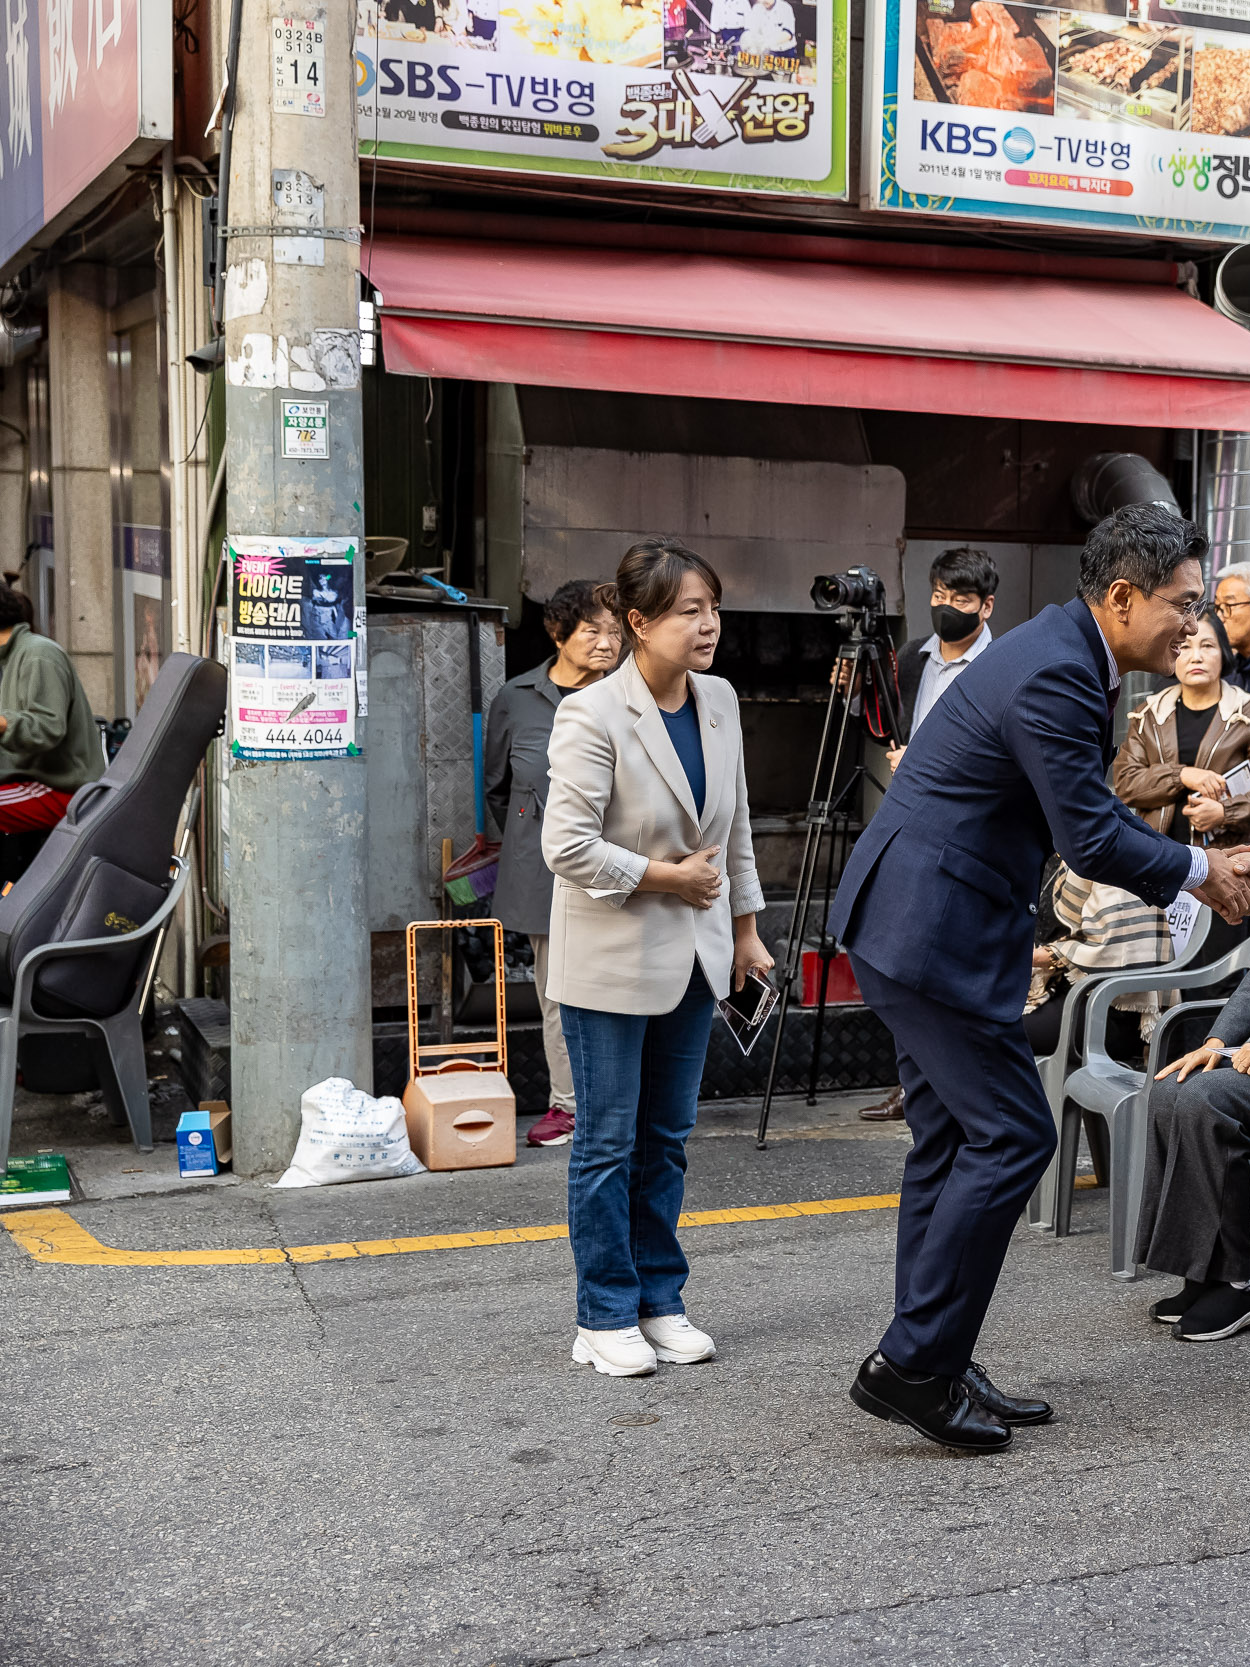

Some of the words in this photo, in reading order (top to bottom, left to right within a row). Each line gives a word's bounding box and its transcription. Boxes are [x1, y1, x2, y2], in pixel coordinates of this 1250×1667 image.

[275, 28, 323, 43] 0324B
[285, 42, 313, 54] 513
[289, 59, 319, 86] 14
[394, 110, 416, 122] 20일
[418, 112, 439, 125] 방영
[458, 114, 499, 131] 백종원의
[501, 119, 541, 135] 맛집탐험
[921, 119, 997, 158] KBS
[918, 163, 949, 177] 2011년
[969, 168, 983, 180] 1일
[985, 170, 1002, 182] 방영
[1028, 172, 1077, 191] 꼬치요리에
[1080, 176, 1111, 194] 빠지다
[285, 193, 313, 205] 513
[288, 416, 324, 428] 자양4동
[296, 429, 317, 440] 772
[241, 560, 271, 574] EVENT
[239, 600, 301, 627] 방송댄스
[266, 728, 343, 745] 444.4044
